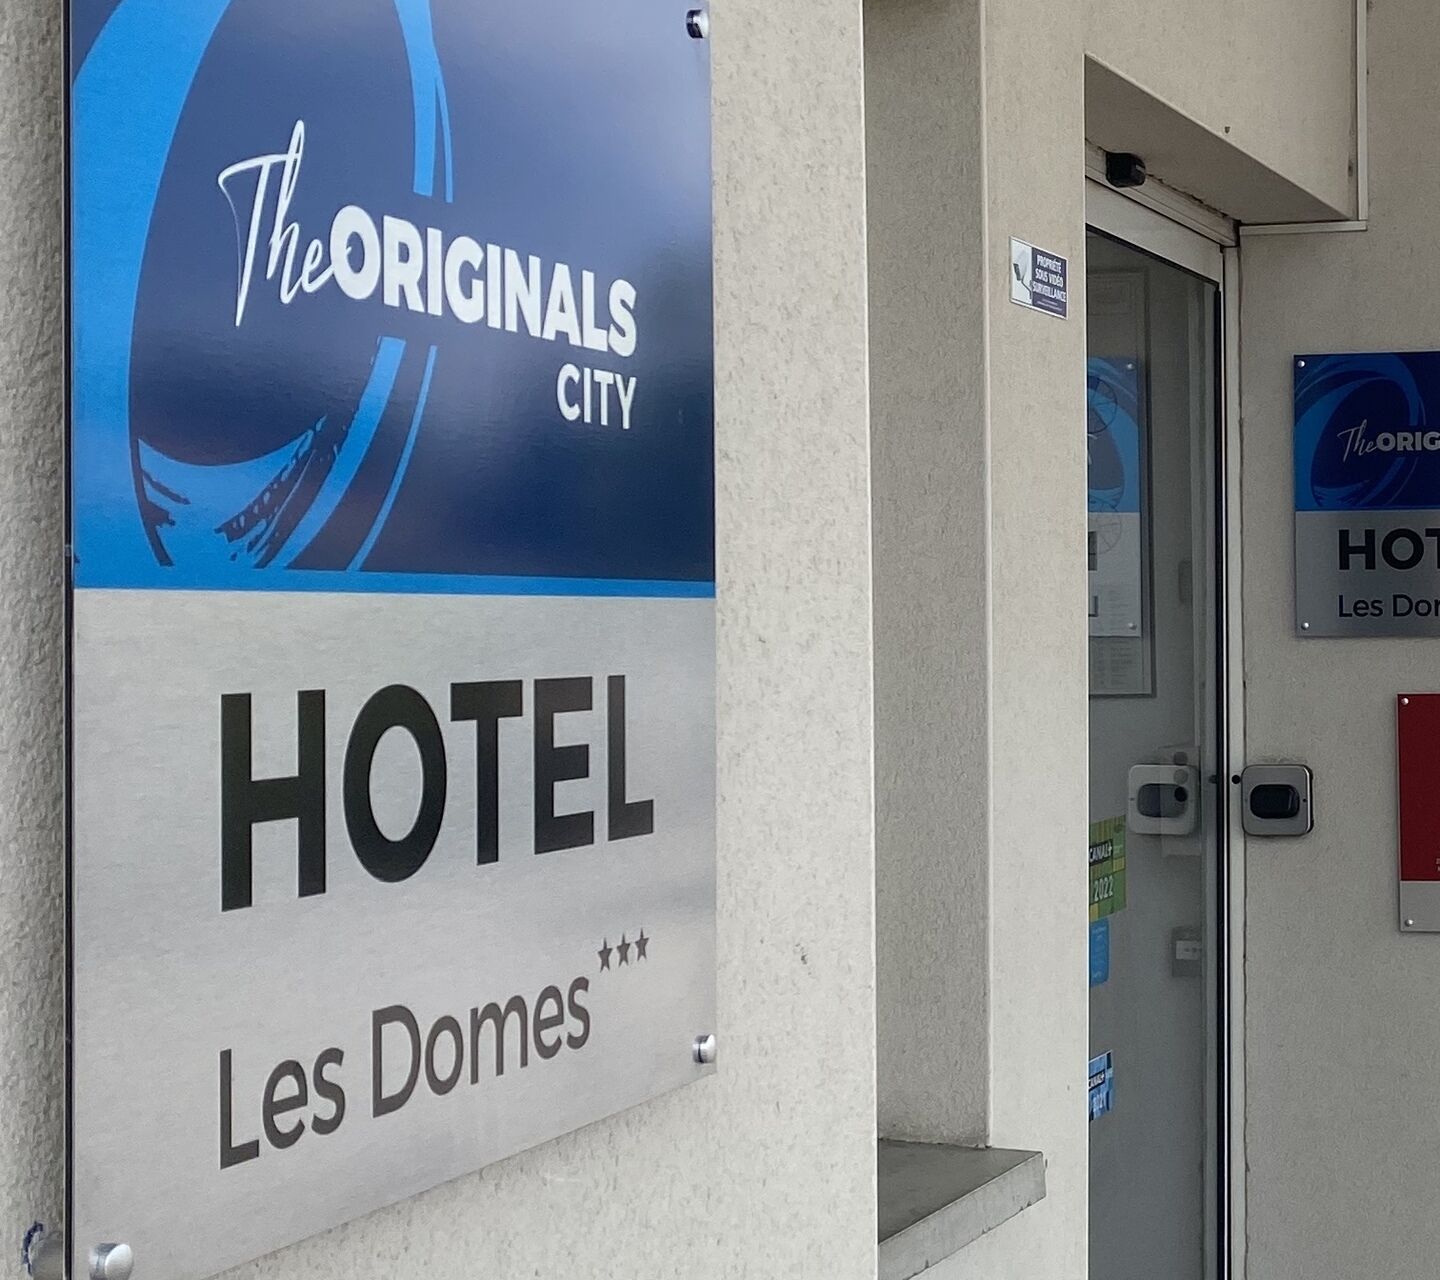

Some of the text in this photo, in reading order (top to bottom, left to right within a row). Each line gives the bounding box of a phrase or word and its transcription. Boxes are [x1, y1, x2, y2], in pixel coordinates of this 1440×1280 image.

[1035, 268, 1048, 282] SOUS
[556, 363, 637, 430] CITY
[1338, 594, 1384, 617] Les
[220, 674, 654, 913] HOTEL
[1093, 875, 1114, 902] 2022
[219, 976, 591, 1170] Les Domes
